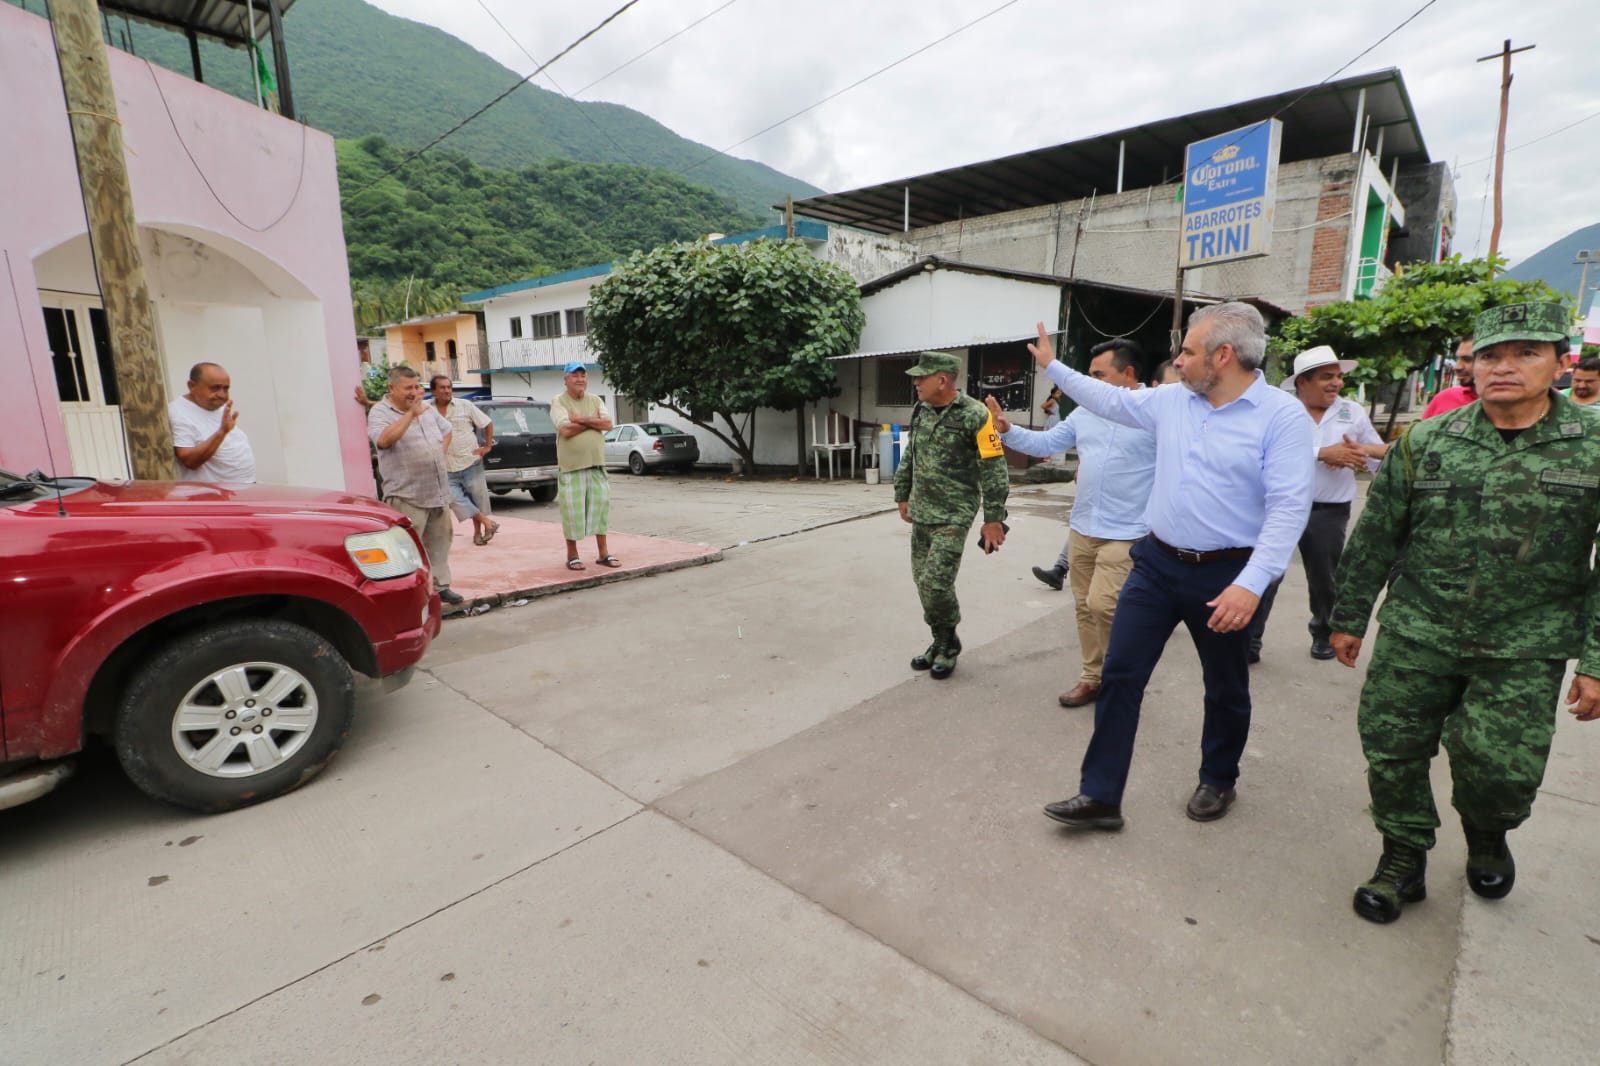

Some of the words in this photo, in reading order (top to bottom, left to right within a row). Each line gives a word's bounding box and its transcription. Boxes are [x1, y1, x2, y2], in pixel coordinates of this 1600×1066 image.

[1191, 155, 1256, 186] Corona
[1207, 178, 1237, 192] Extra
[1186, 201, 1261, 232] ABARROTES
[1186, 223, 1250, 261] TRINI
